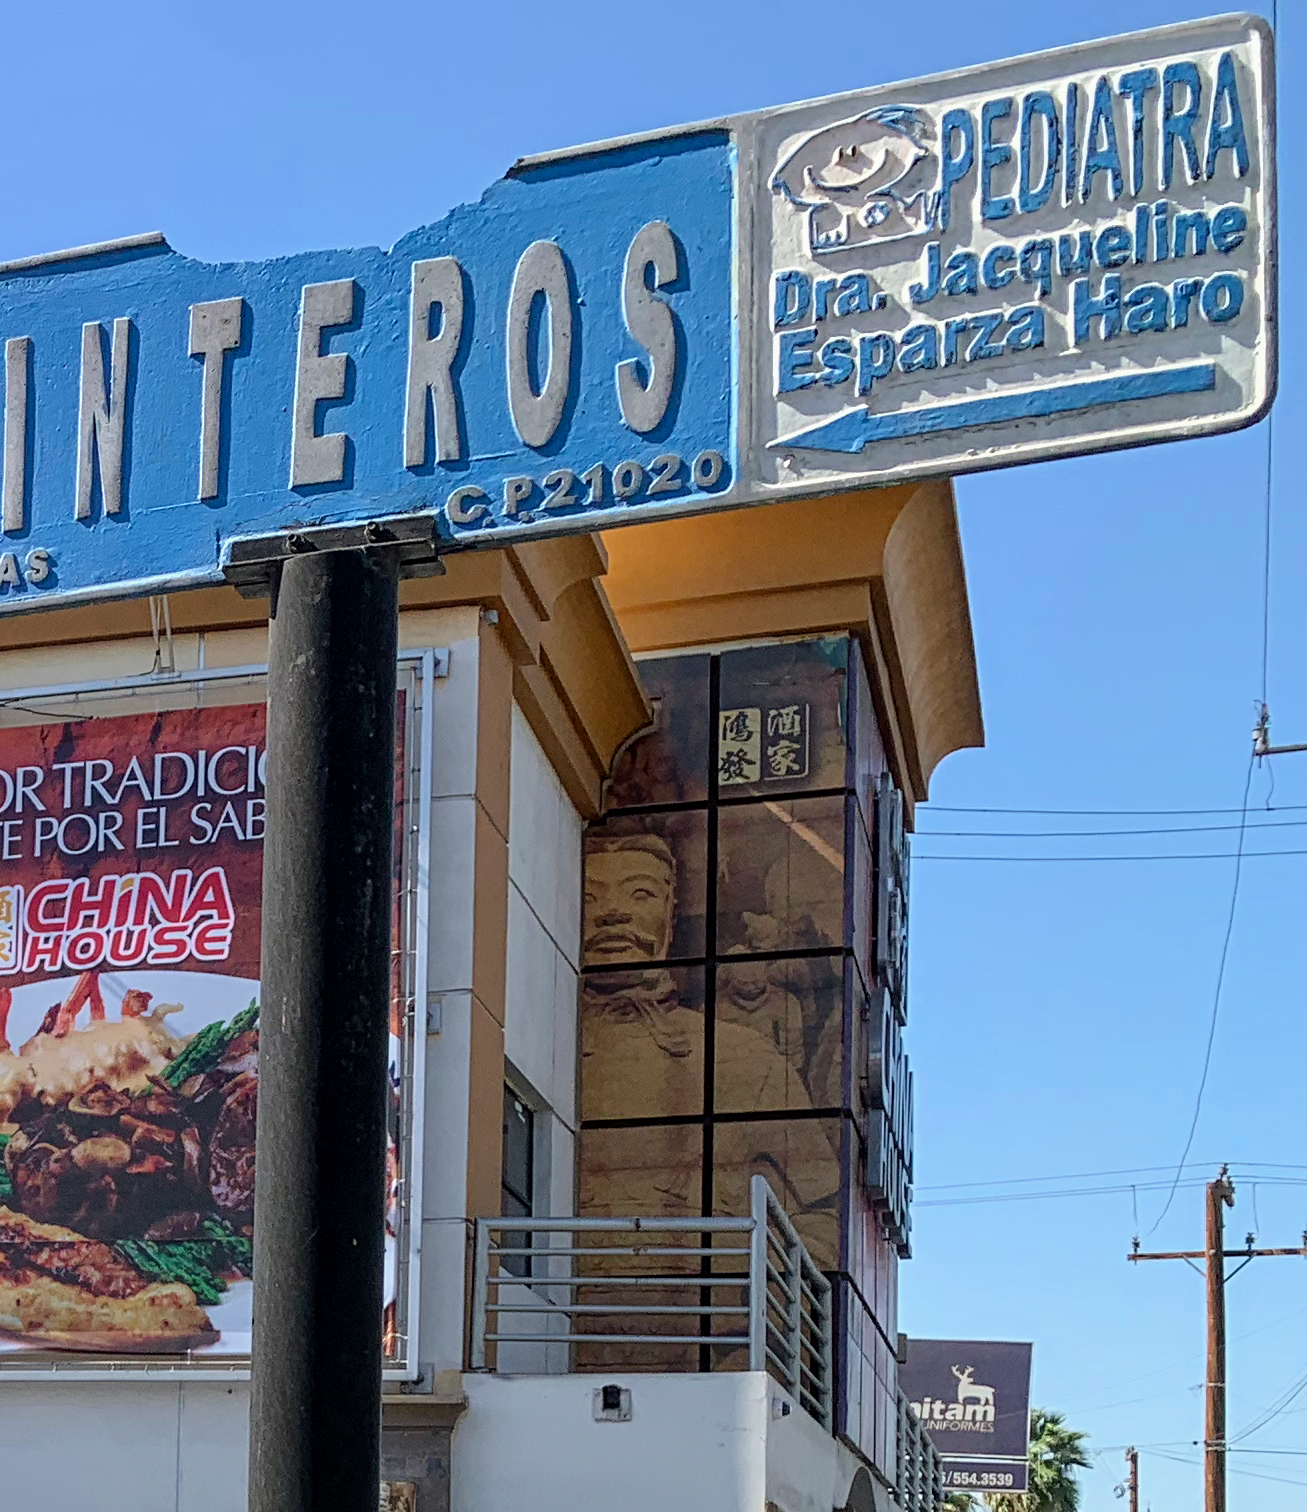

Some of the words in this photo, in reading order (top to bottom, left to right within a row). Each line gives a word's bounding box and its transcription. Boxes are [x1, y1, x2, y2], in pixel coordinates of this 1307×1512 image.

[938, 51, 1250, 233] PEDIATRA
[772, 268, 888, 328] Dra.
[907, 200, 1249, 305] Jacqueline
[773, 302, 1046, 396] Esparza
[1071, 271, 1246, 348] Haro
[52, 745, 266, 811] TRADICI
[34, 812, 125, 857] POR
[136, 806, 180, 849] EL
[189, 799, 266, 846] SAB
[26, 868, 233, 935] CHINA
[24, 922, 231, 971] HOUSE
